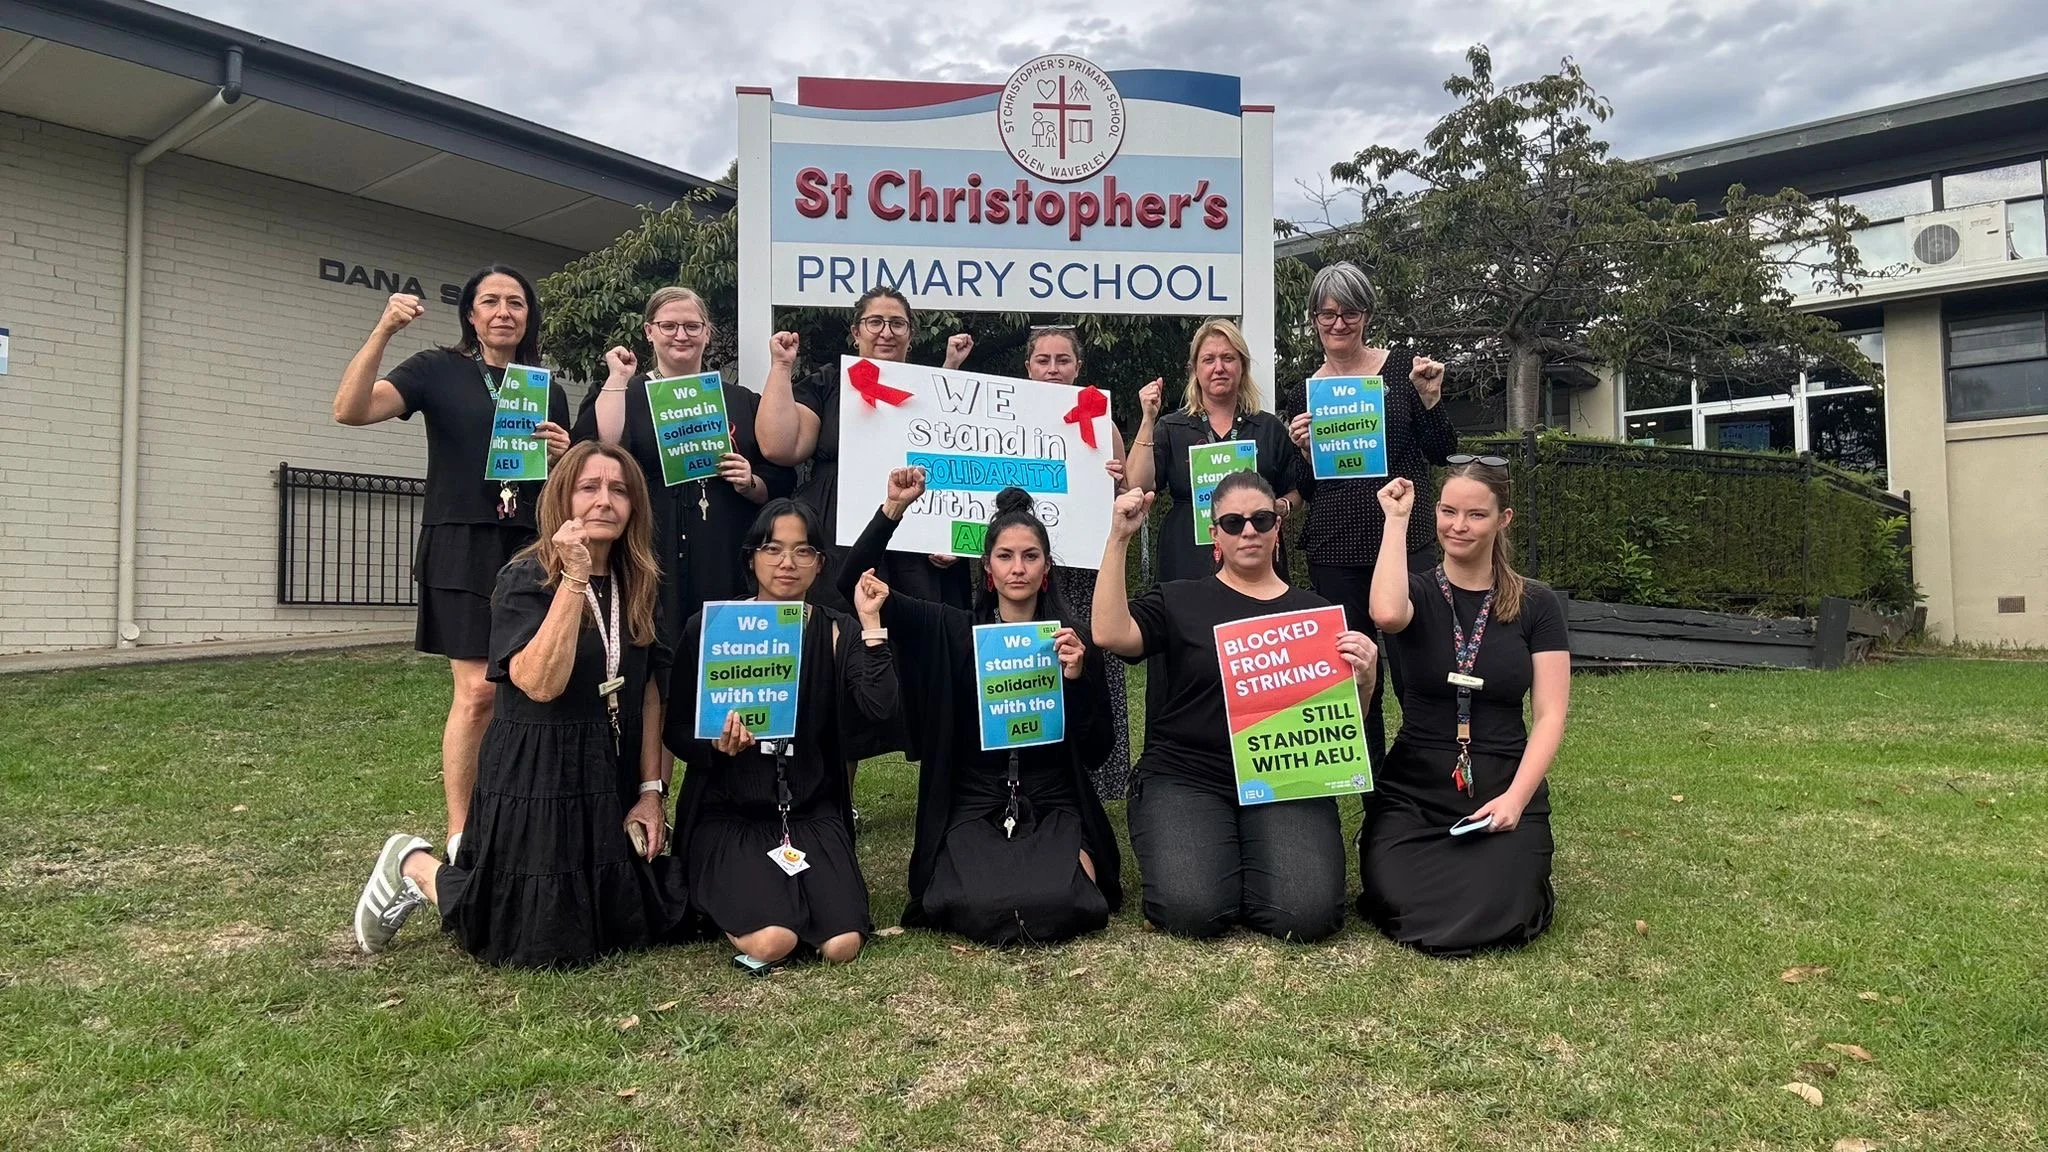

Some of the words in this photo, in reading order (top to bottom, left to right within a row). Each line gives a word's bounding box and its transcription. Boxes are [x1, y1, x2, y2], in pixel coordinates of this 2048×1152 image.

[1068, 60, 1111, 92] PRIMARY
[1004, 58, 1065, 117] CHRISTOPHER'S
[1106, 93, 1120, 138] SCHOOL
[1004, 120, 1014, 134] ST
[1018, 148, 1045, 172] GLEN
[1050, 151, 1107, 177] WAVERLEY
[795, 166, 852, 220] St
[868, 169, 1228, 242] Christopher's
[320, 258, 426, 300] DANA
[798, 255, 1015, 298] PRIMARY
[1029, 262, 1228, 302] SCHOOL
[673, 387, 697, 400] We
[932, 374, 1016, 420] WE
[1332, 386, 1356, 397] We
[522, 397, 538, 412] in
[660, 402, 701, 421] stand
[704, 402, 718, 414] in
[1316, 402, 1357, 416] stand
[1360, 400, 1374, 412] in
[664, 420, 722, 440] solidarity
[1316, 418, 1378, 435] solidarity
[511, 438, 538, 450] the
[668, 442, 699, 457] with
[701, 439, 724, 451] the
[1033, 427, 1066, 460] in
[1319, 439, 1350, 452] with
[1353, 438, 1377, 450] the
[495, 459, 519, 470] AEU
[688, 458, 712, 471] AEU
[1210, 453, 1231, 464] We
[1338, 457, 1362, 469] AEU
[912, 458, 1065, 488] SOLIDARITY
[738, 616, 768, 630] We
[1004, 634, 1031, 649] We
[1224, 620, 1319, 656] BLOCKED
[712, 640, 768, 656] stand
[772, 639, 790, 654] in
[985, 655, 1033, 671] stand
[1037, 653, 1051, 666] in
[1229, 648, 1290, 676] FROM
[710, 663, 792, 681] solidarity
[1235, 661, 1337, 697] STRIKING.
[987, 674, 1055, 694] solidarity
[710, 688, 754, 704] with
[758, 688, 789, 702] the
[989, 699, 1026, 715] with
[1029, 697, 1055, 711] the
[1302, 703, 1354, 723] STILL
[1011, 720, 1038, 736] AEU
[1247, 725, 1357, 752] STANDING
[1252, 752, 1309, 773] WITH
[1315, 746, 1361, 767] AEU.
[1245, 789, 1264, 800] IEU
